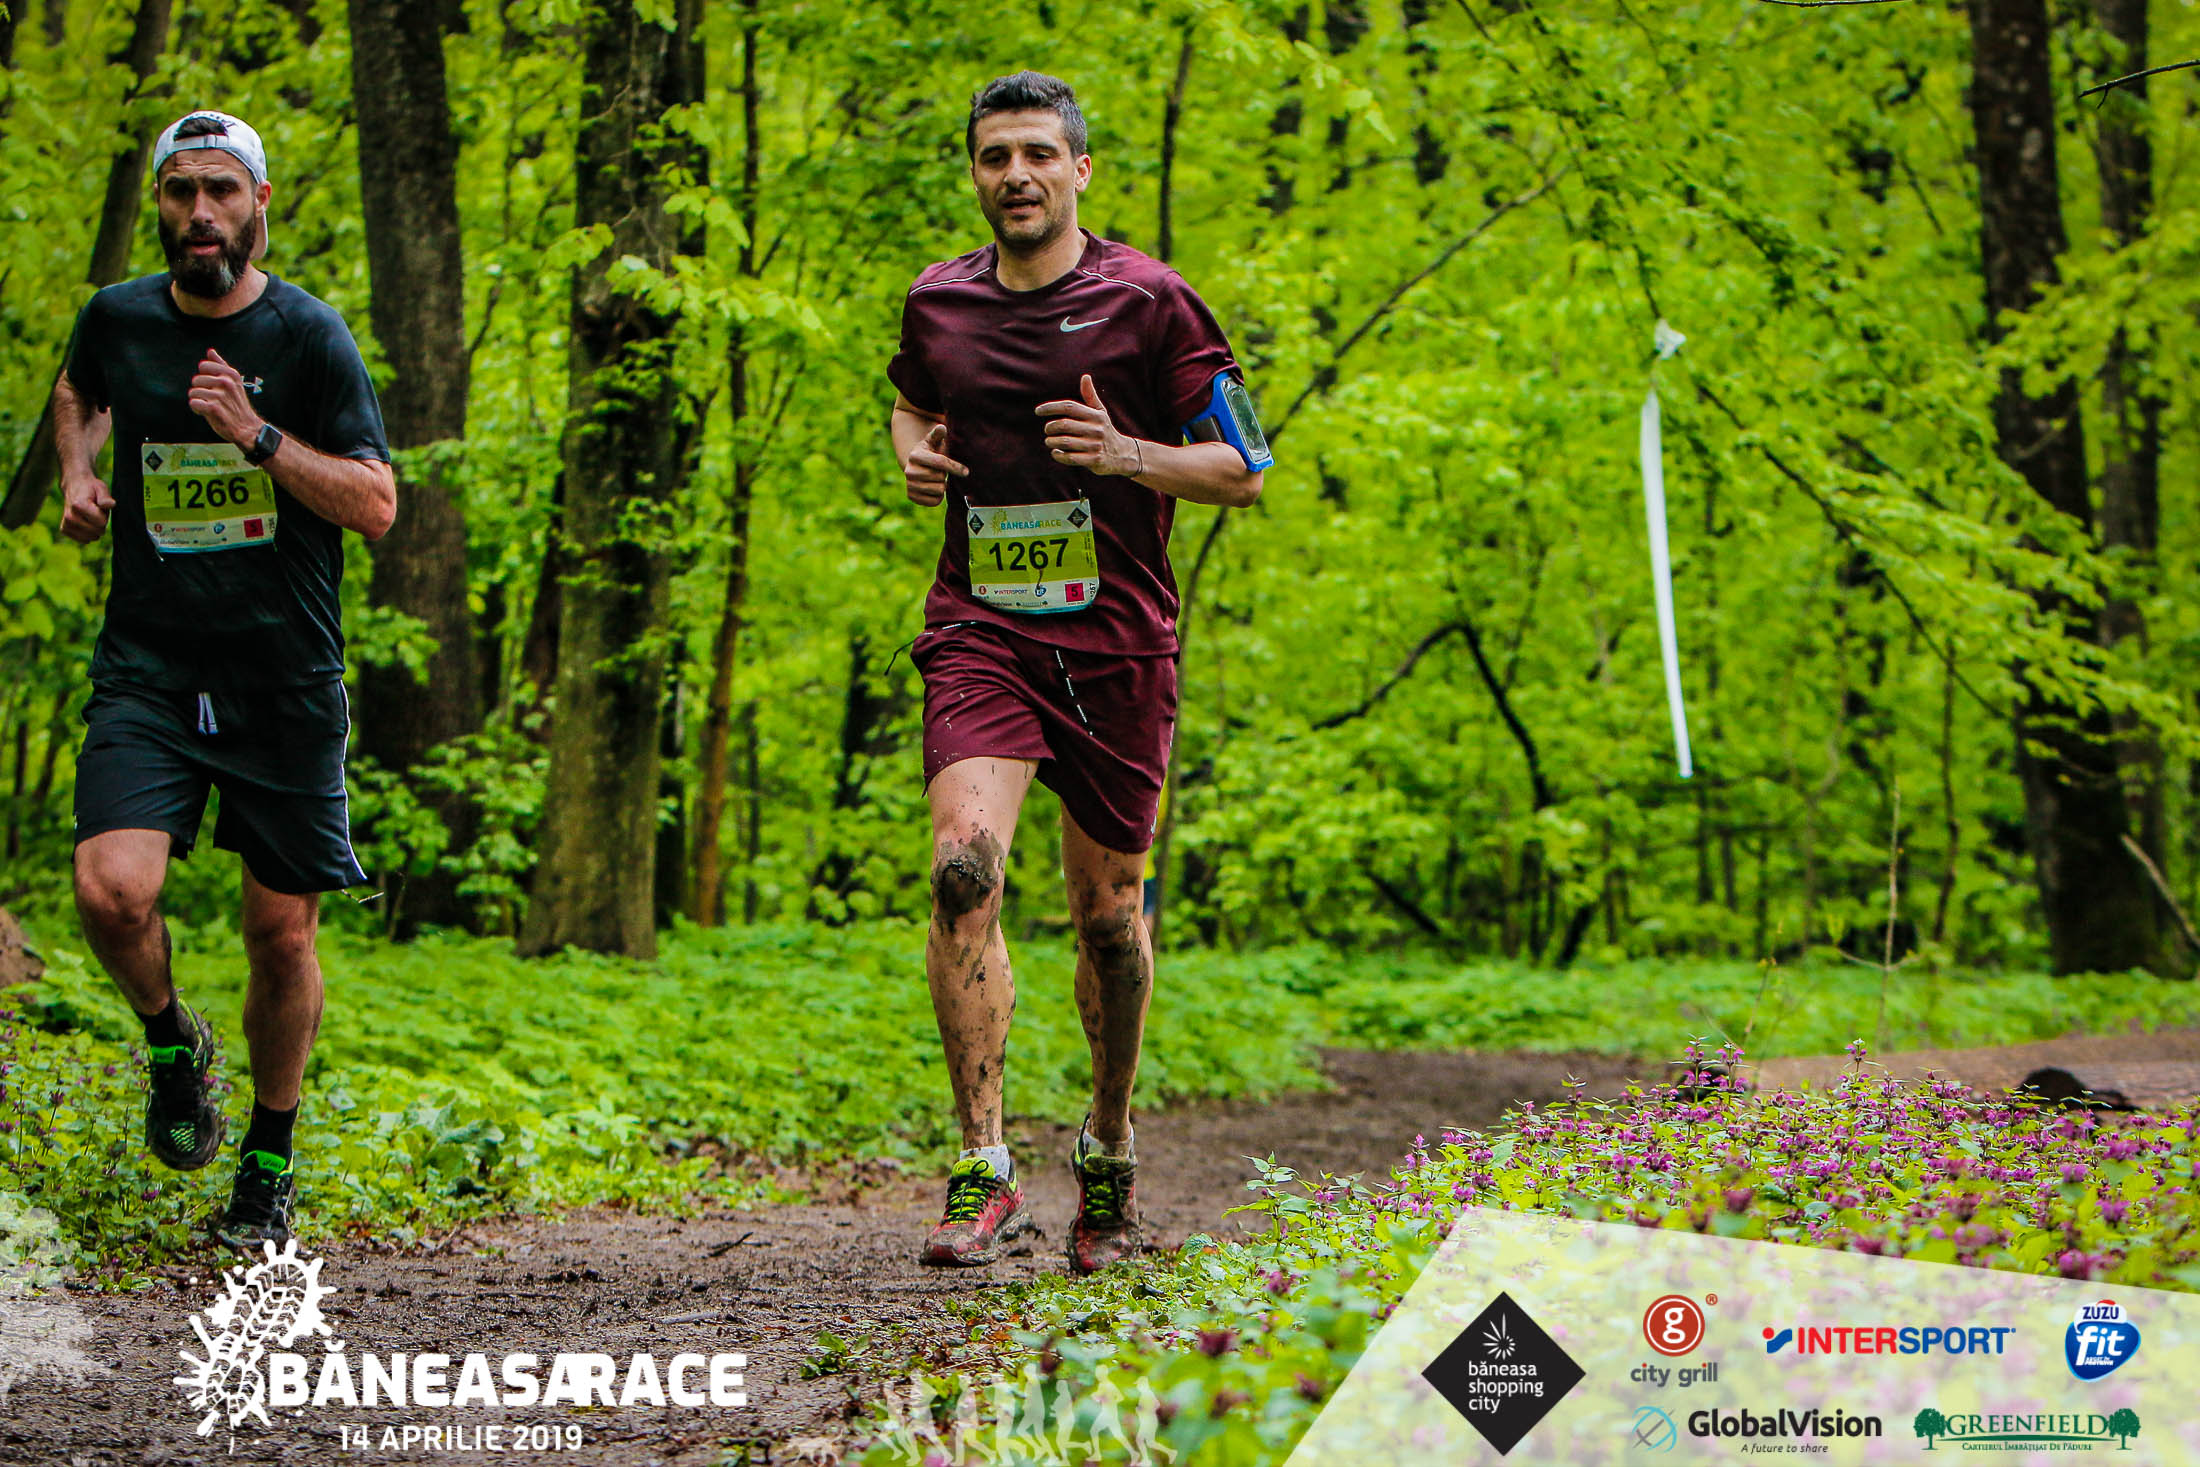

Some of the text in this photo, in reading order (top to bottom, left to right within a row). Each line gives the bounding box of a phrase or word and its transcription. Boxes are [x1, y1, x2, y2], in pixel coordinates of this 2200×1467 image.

[167, 476, 249, 509] 1266
[989, 538, 1069, 571] 1267
[1070, 584, 1079, 597] 5
